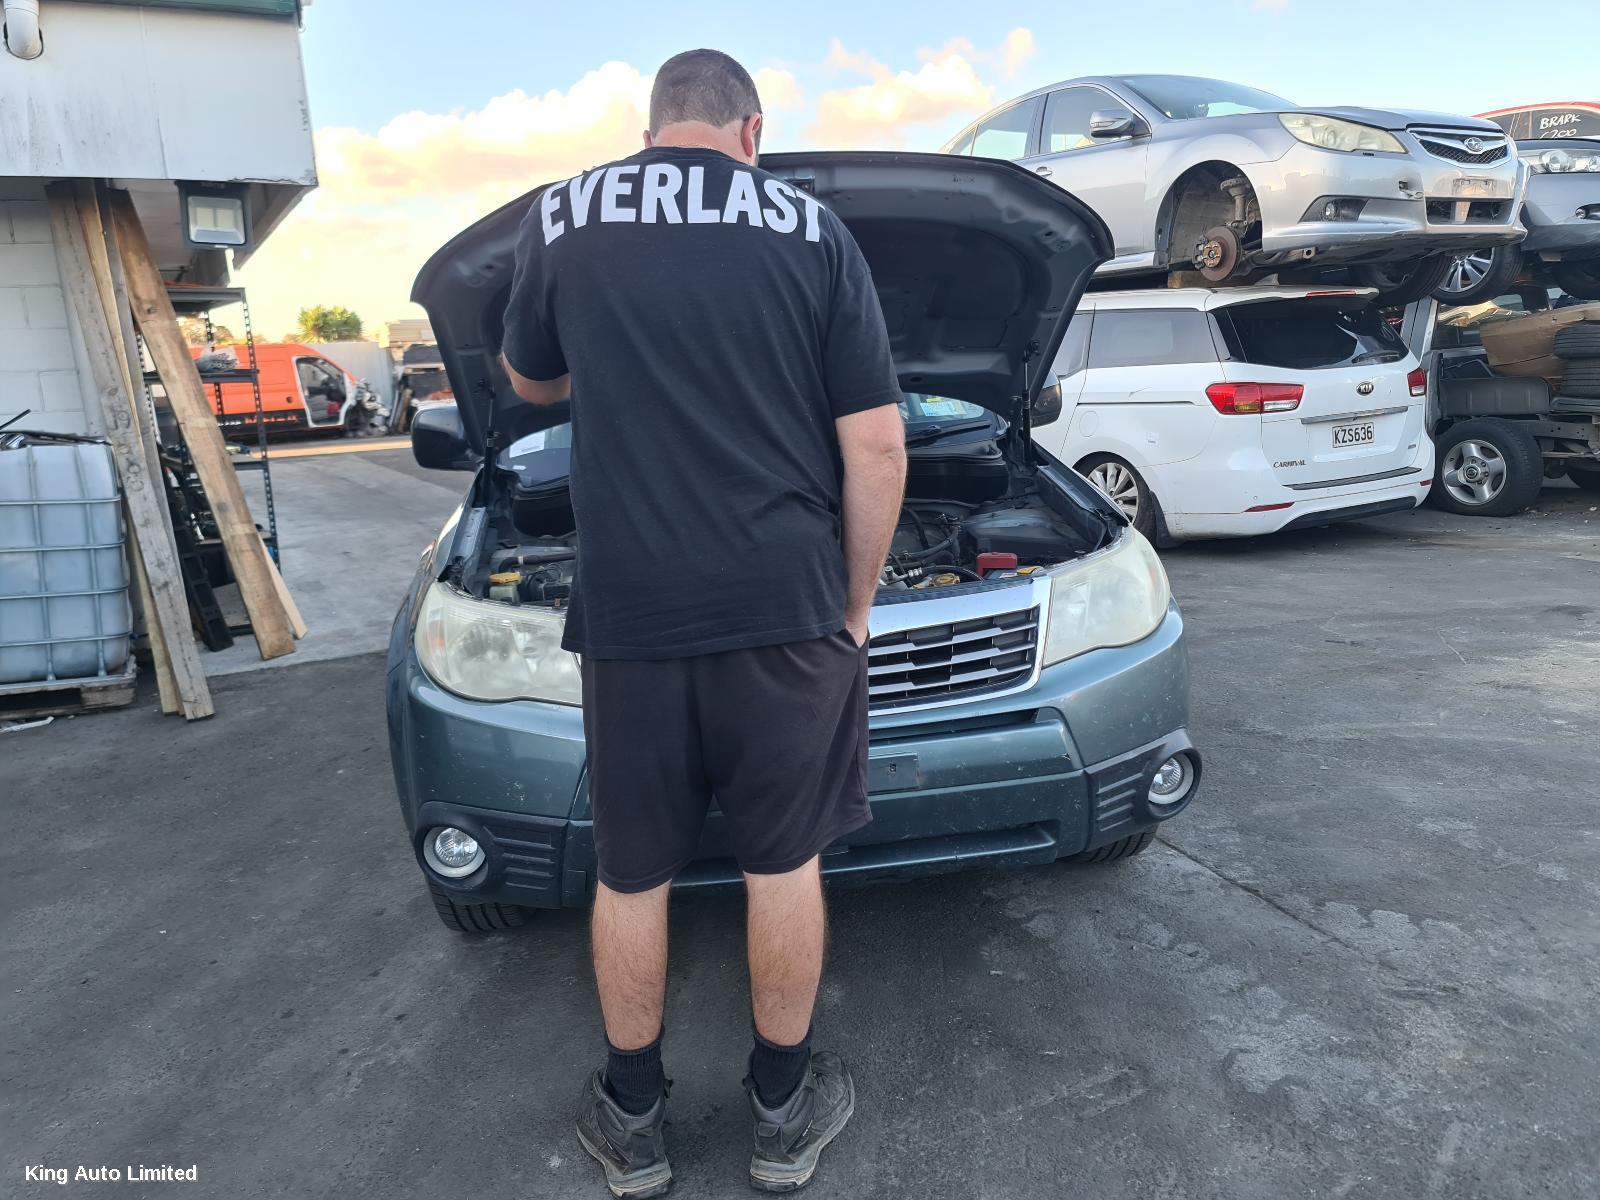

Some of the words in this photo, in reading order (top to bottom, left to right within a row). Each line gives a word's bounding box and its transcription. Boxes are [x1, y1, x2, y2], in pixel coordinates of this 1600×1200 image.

[541, 163, 825, 246] EVERLAST
[1334, 425, 1373, 444] KZS636
[1273, 459, 1307, 469] CARNIVAL
